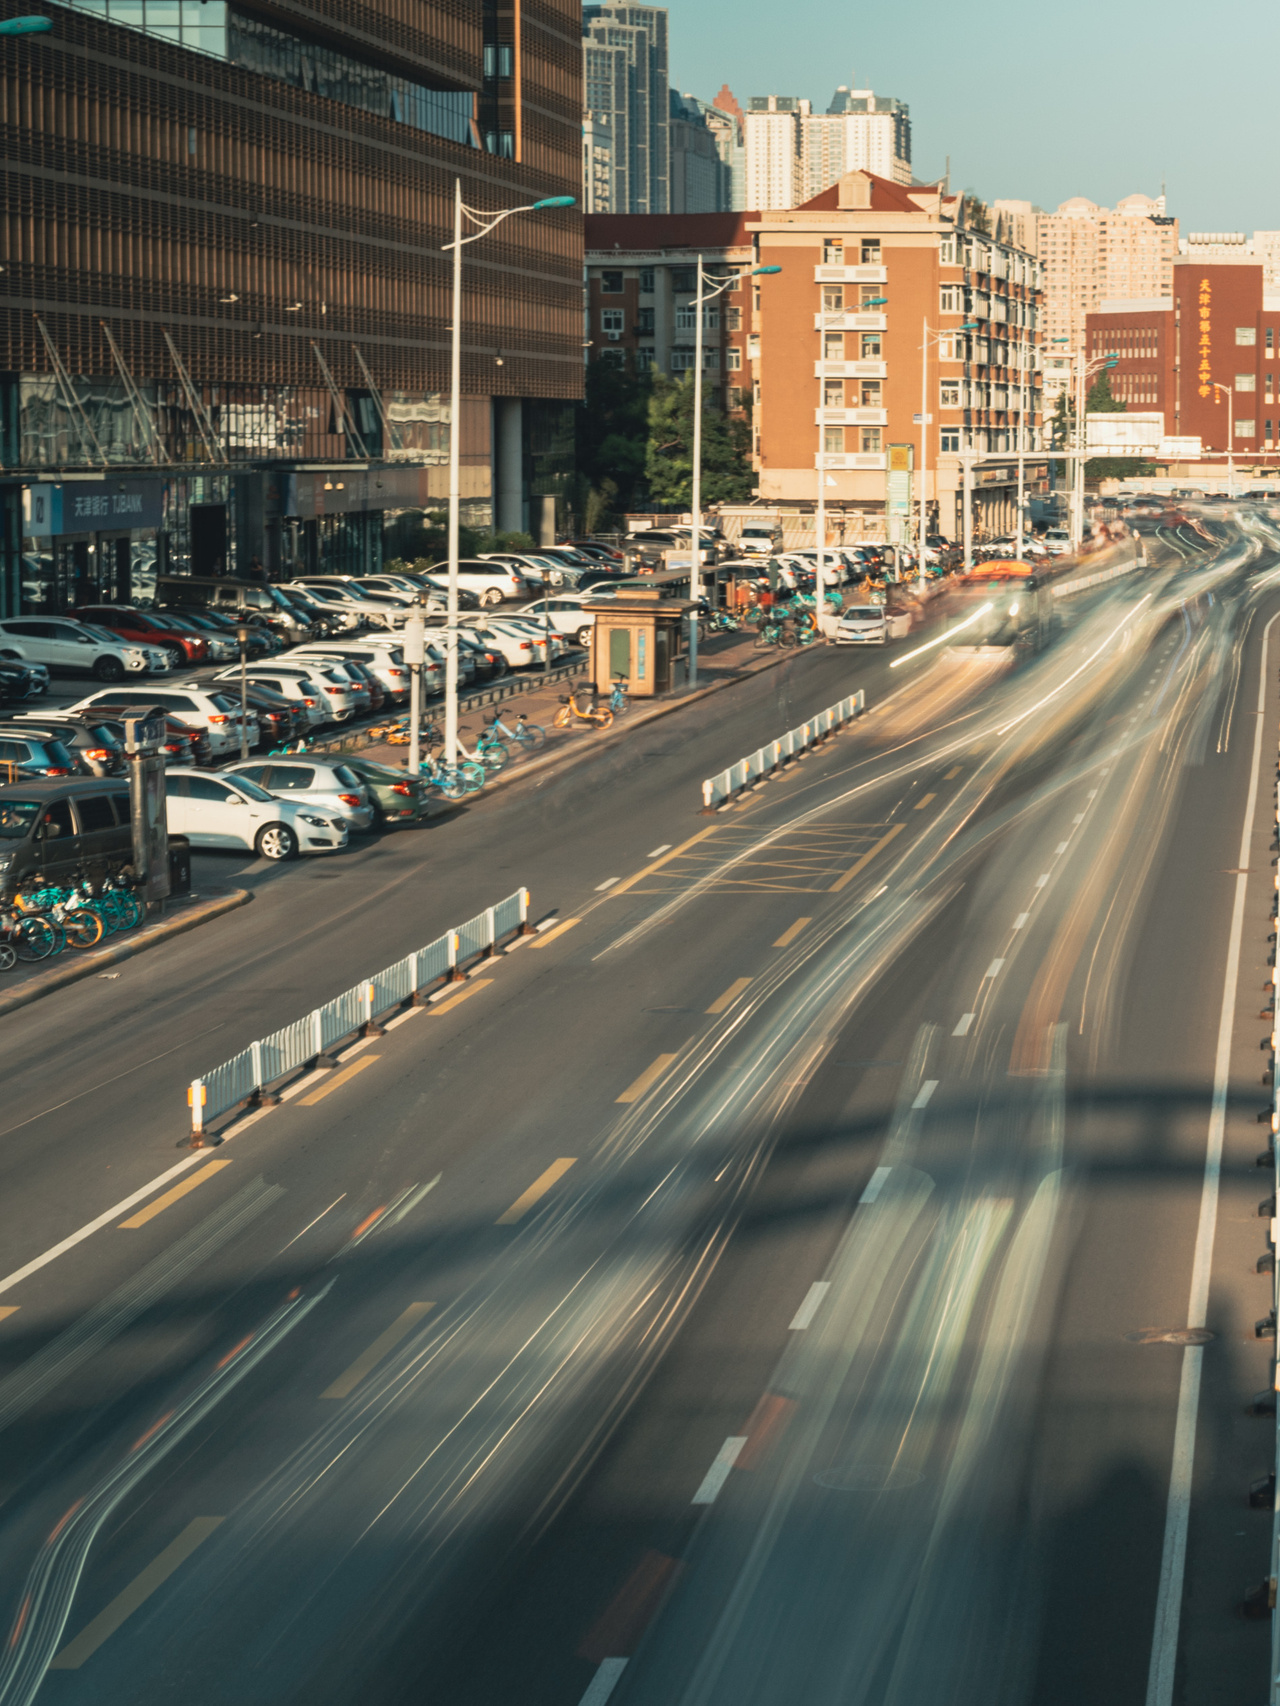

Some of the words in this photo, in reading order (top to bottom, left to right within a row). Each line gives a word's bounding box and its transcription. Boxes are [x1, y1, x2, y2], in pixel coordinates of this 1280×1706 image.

[1198, 279, 1212, 398] 天津市第五十五中学
[74, 495, 110, 517] 天津银行
[112, 494, 143, 514] TJBANK
